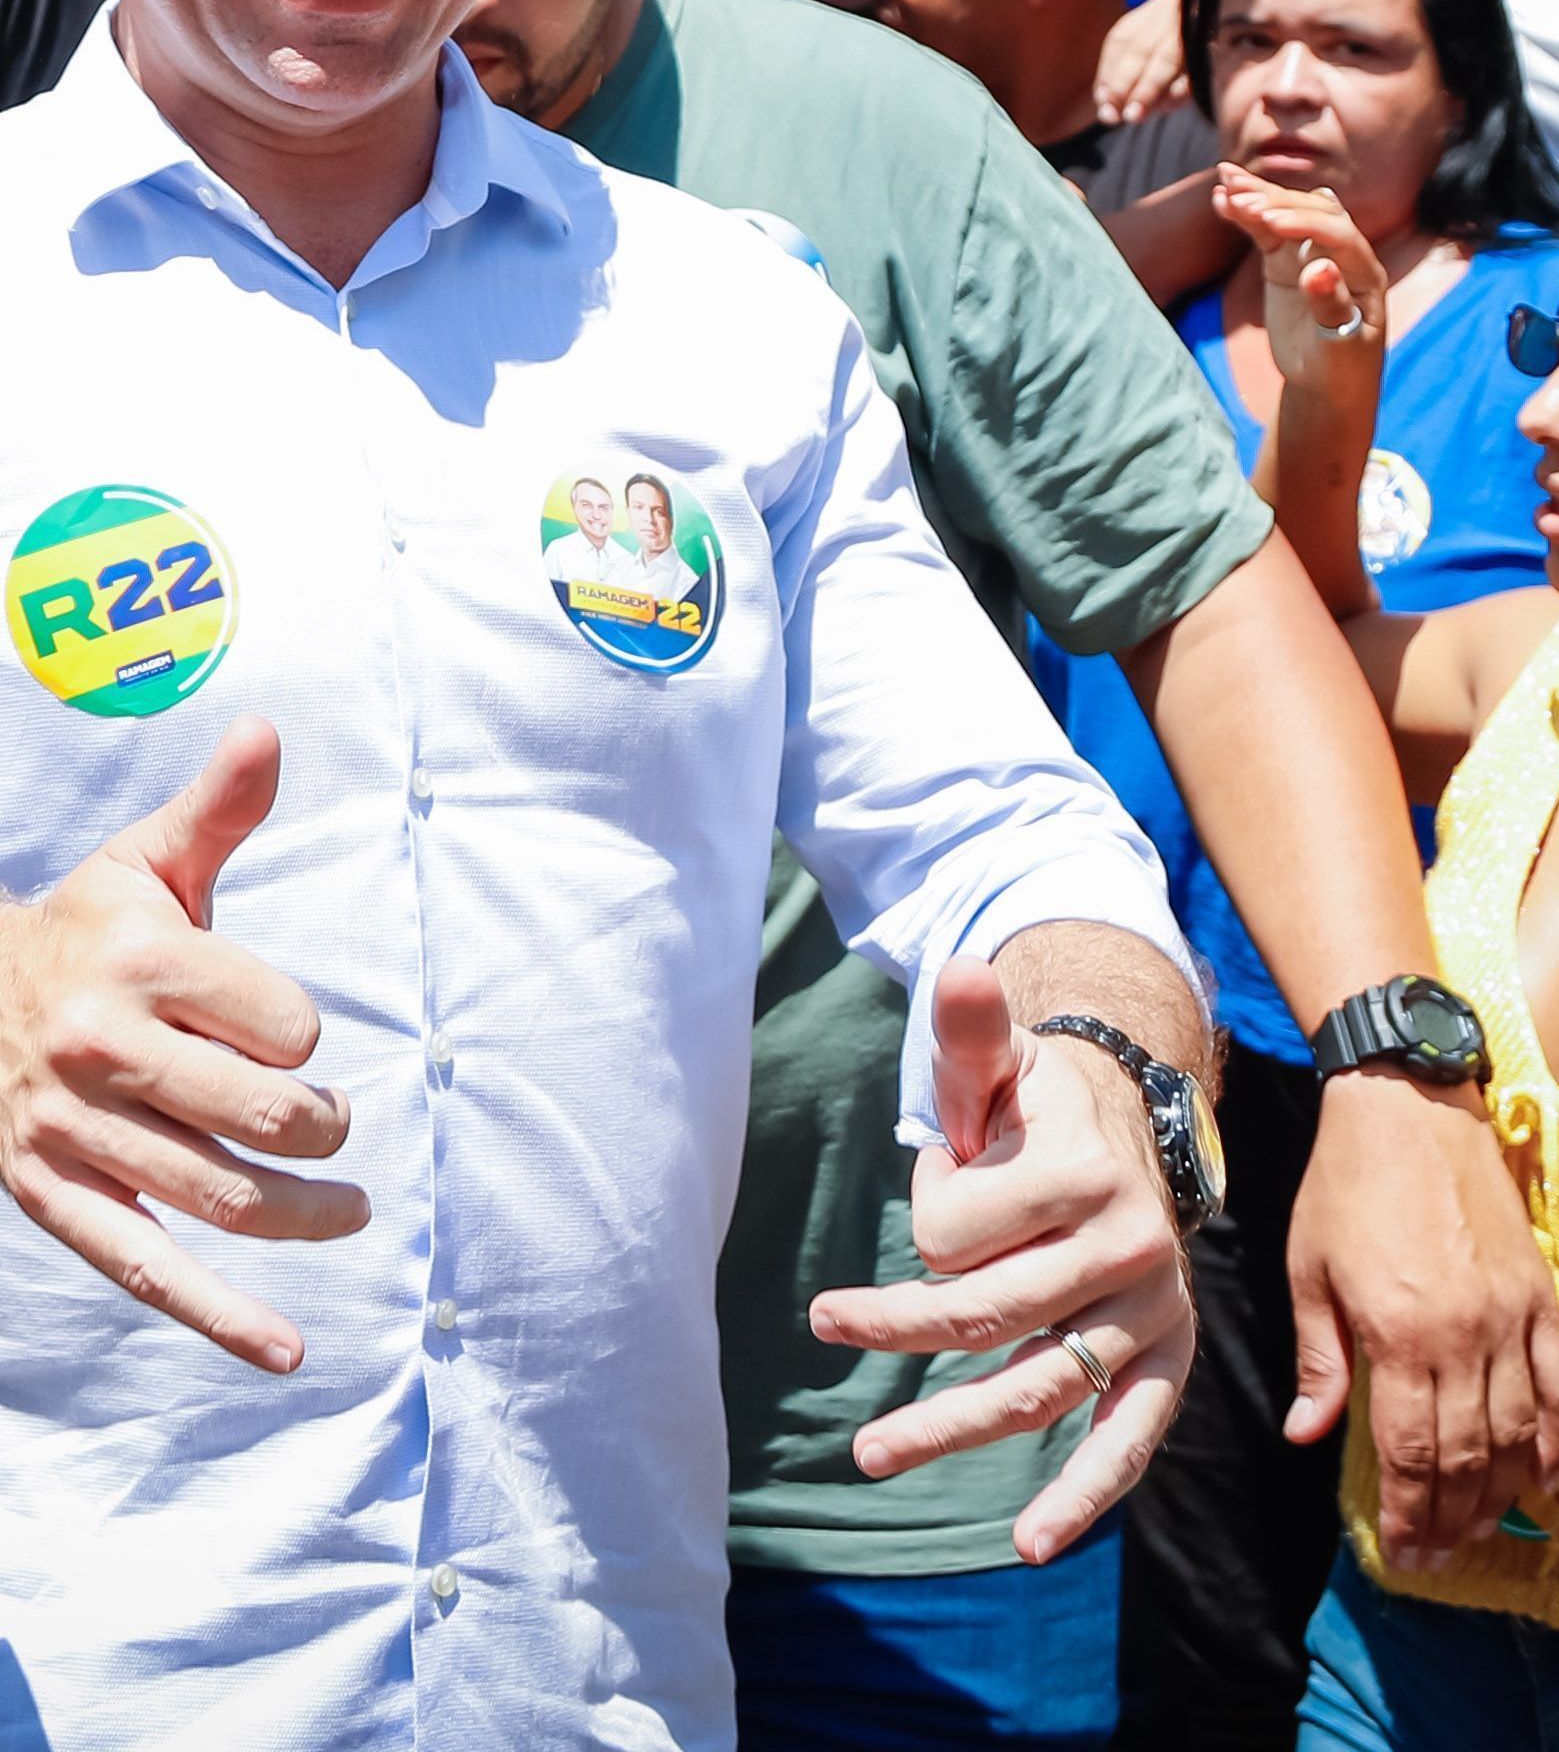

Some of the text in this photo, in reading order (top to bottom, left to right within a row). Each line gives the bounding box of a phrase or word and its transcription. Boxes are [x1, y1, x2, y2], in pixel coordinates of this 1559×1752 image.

[19, 539, 225, 660] R22
[576, 584, 649, 610] RAMAGEM
[656, 597, 702, 638] 22
[117, 653, 172, 681] RAMAGEM
